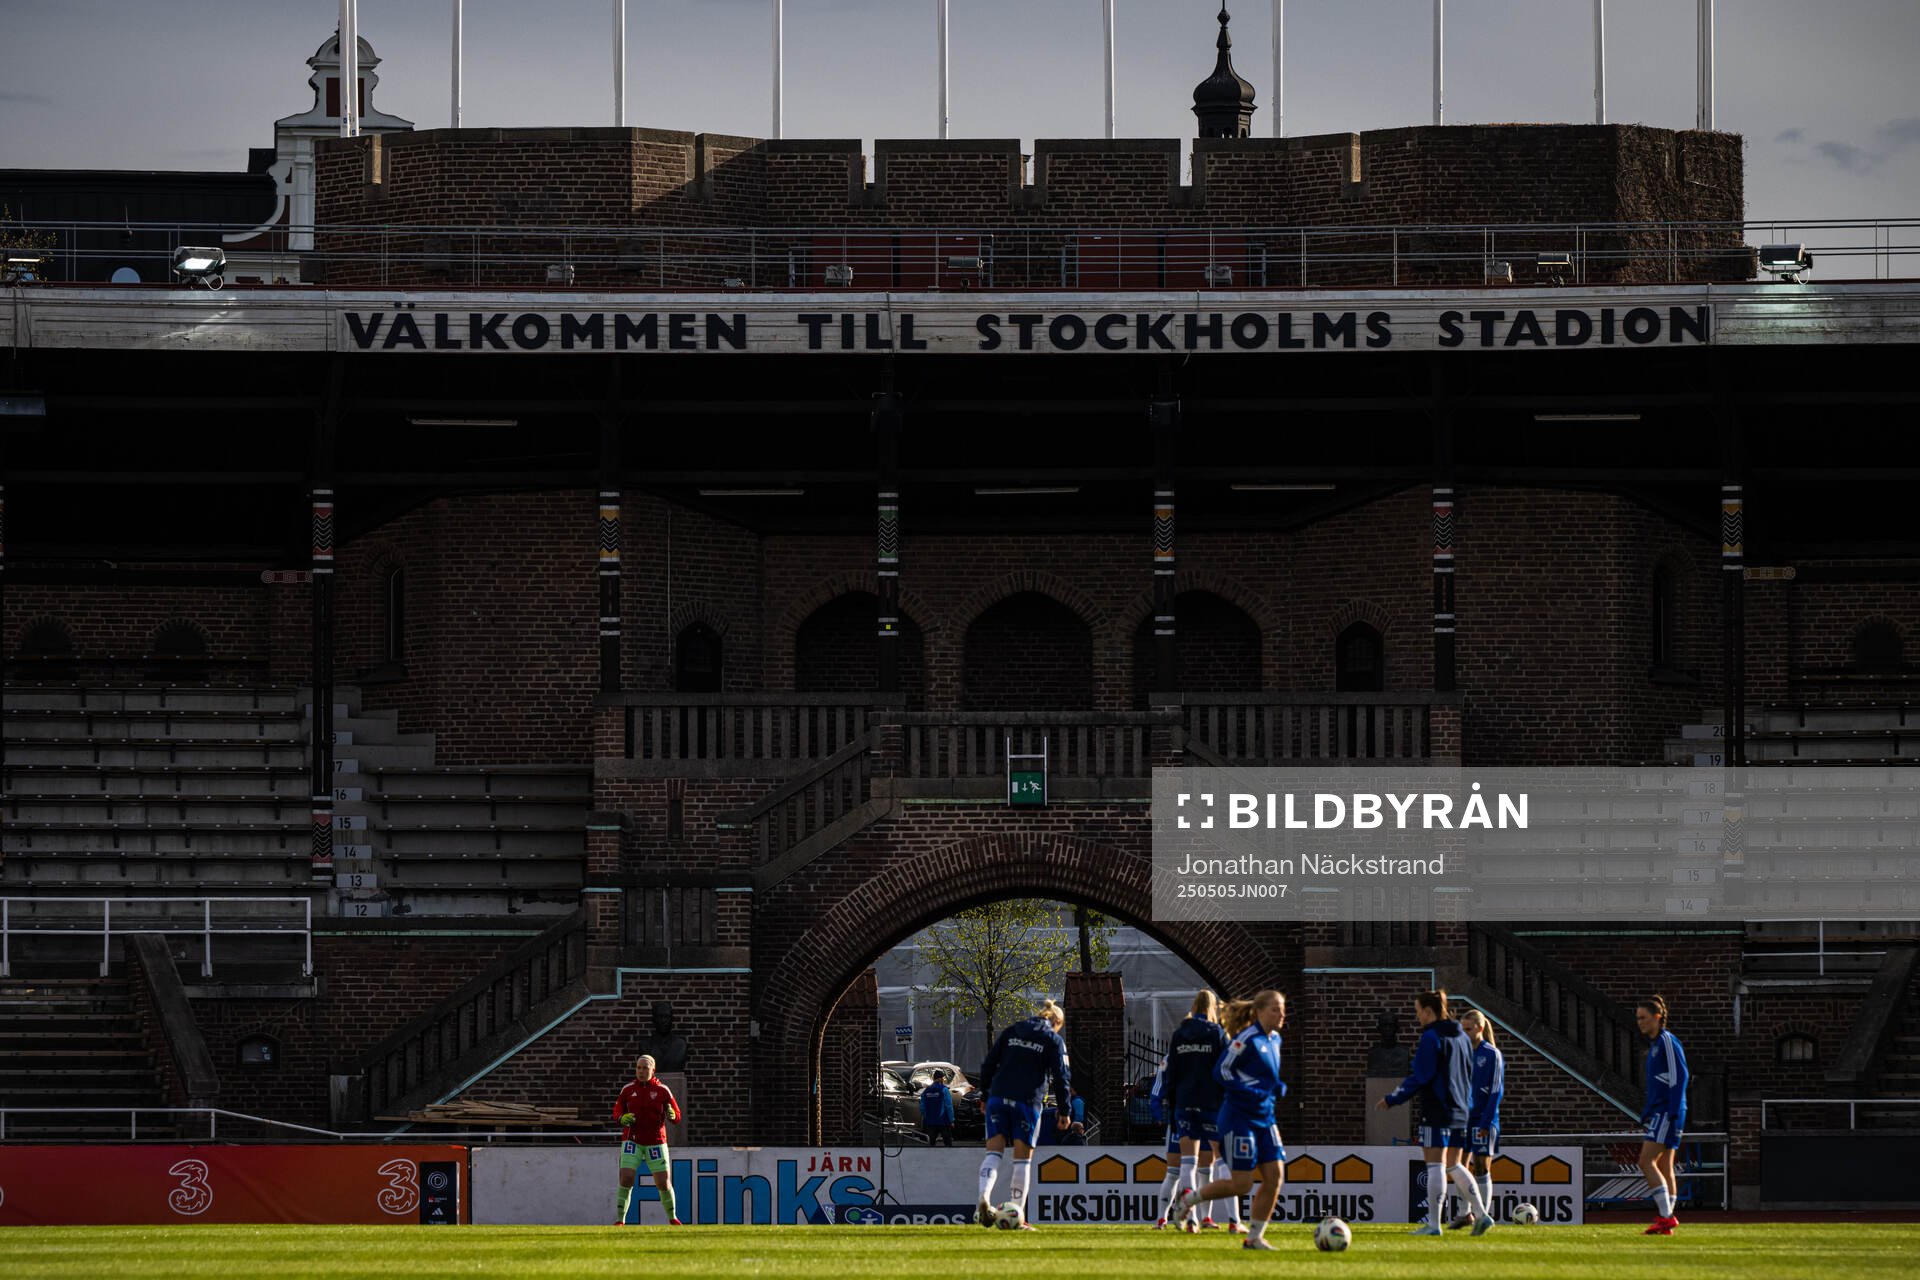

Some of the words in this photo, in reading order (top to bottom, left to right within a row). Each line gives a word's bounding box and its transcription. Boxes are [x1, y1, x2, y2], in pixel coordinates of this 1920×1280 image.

[344, 302, 747, 350] VÄLKOMMEN
[798, 313, 927, 350] TILL
[976, 312, 1392, 350] STOCKHOLMS
[1438, 306, 1711, 348] STADION
[1709, 755, 1721, 766] 19
[335, 789, 347, 801] 16
[339, 817, 351, 829] 15
[344, 847, 357, 858] 14
[350, 875, 362, 887] 13
[355, 904, 368, 916] 12
[807, 1151, 872, 1173] JÄRN
[1038, 1190, 1174, 1222] EKSJÖHU
[1239, 1189, 1374, 1222] ESJÖHUS
